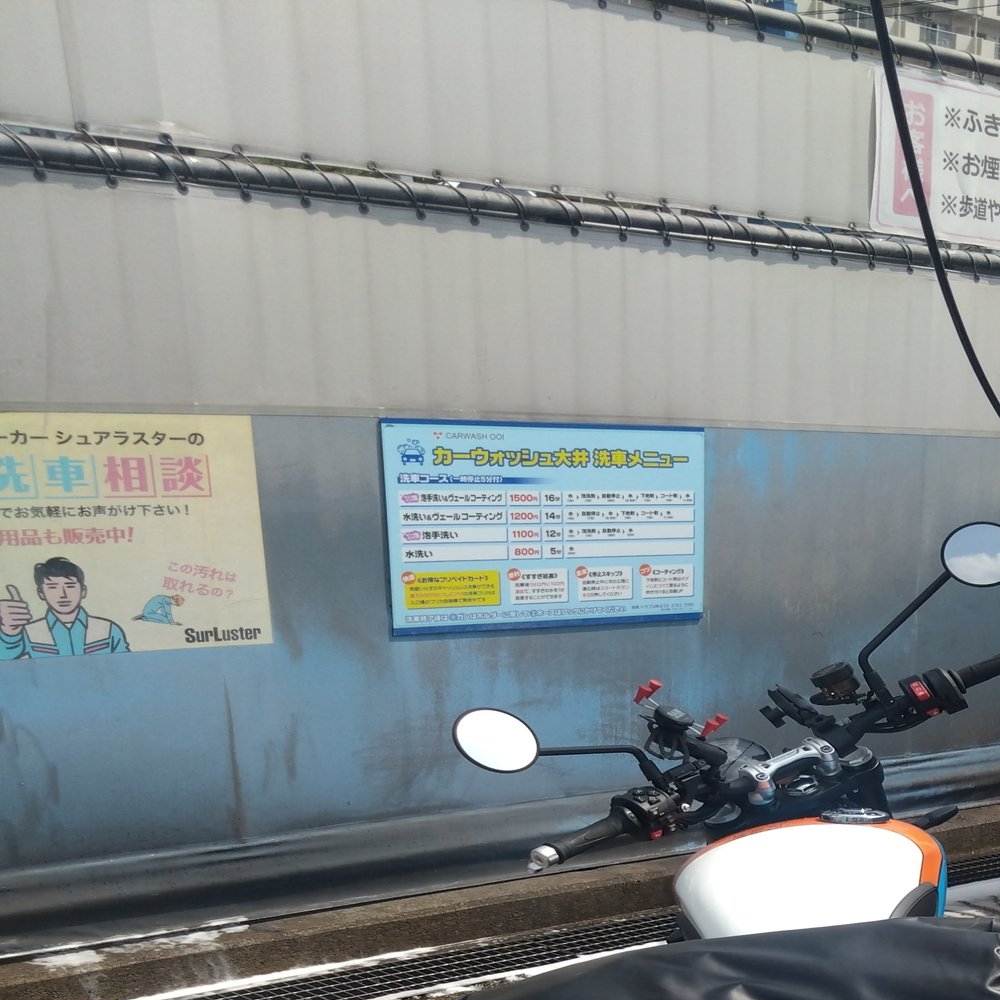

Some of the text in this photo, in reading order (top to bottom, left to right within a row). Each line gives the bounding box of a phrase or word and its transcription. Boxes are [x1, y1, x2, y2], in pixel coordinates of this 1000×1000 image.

[56, 431, 204, 446] シュアラスターの
[446, 432, 488, 441] CARWASH
[432, 446, 689, 468] カーウォッシュ大井 洗車メニュー
[405, 550, 433, 558] 水洗い
[168, 562, 237, 582] この汚れは
[162, 576, 234, 599] 取れるの？
[184, 627, 261, 643] SurLuster
